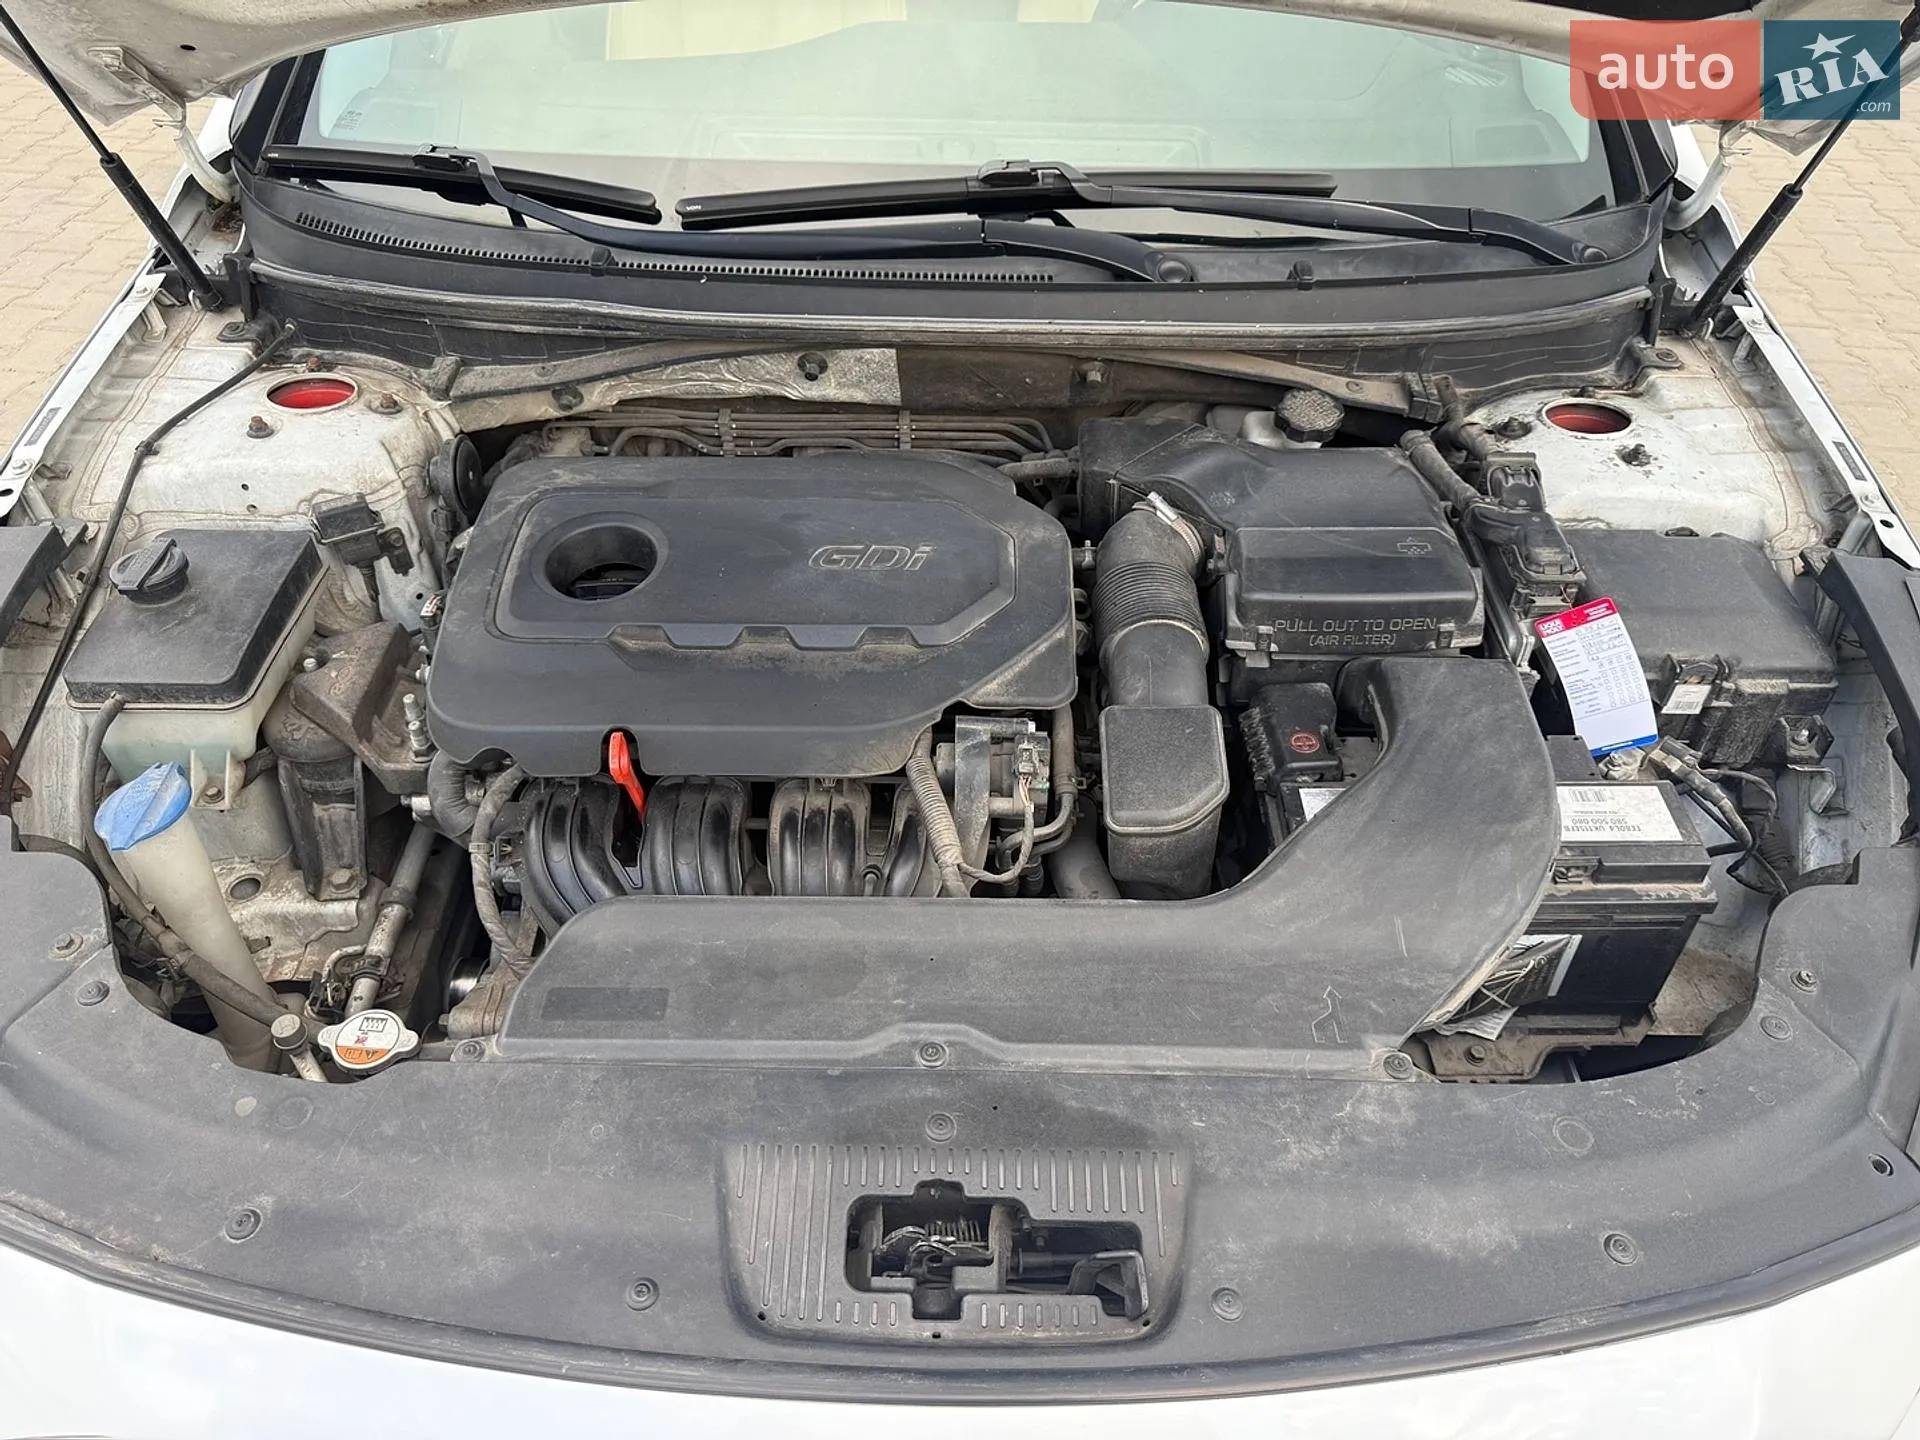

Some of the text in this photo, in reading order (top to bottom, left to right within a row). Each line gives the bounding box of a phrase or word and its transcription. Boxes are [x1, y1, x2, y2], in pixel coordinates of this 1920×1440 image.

[808, 542, 937, 571] GDi
[1274, 617, 1437, 632] PULL OUT TO OPEN
